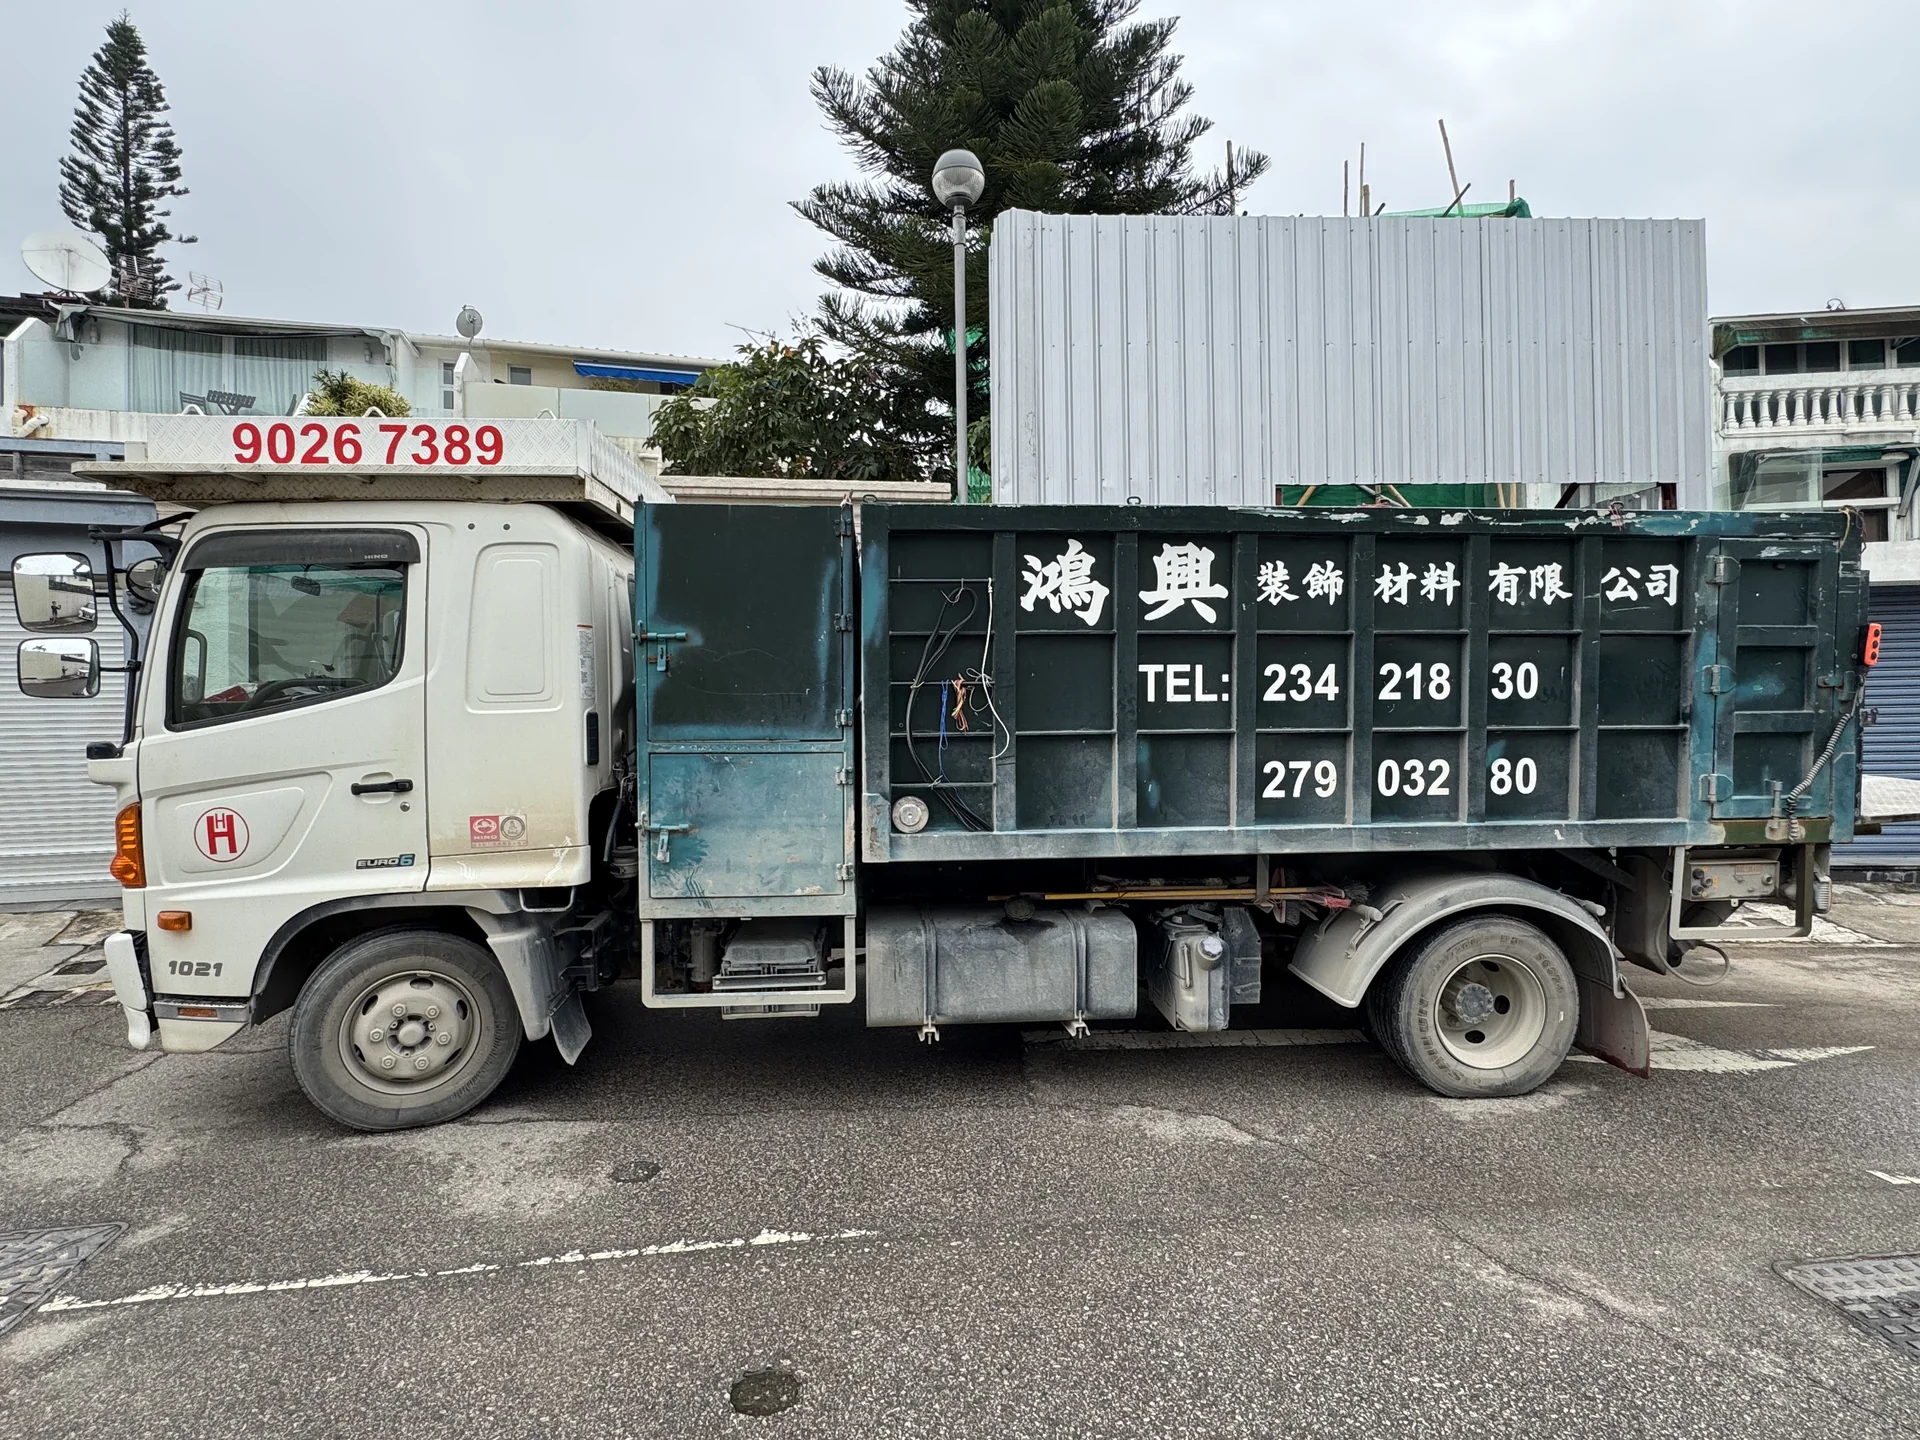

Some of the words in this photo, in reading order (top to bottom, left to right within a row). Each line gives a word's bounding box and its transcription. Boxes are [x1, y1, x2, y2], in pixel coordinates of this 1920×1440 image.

[233, 422, 362, 464] 9026
[381, 424, 503, 465] 7389
[1138, 663, 1229, 703] TEL:
[1262, 663, 1339, 702] 234
[1378, 662, 1451, 701] 218
[1491, 661, 1539, 700] 30
[1261, 759, 1338, 799] 279
[1377, 758, 1451, 797] 032
[1489, 757, 1538, 796] 80
[168, 960, 223, 977] 1021
[1417, 996, 1464, 1081] SAILUN
